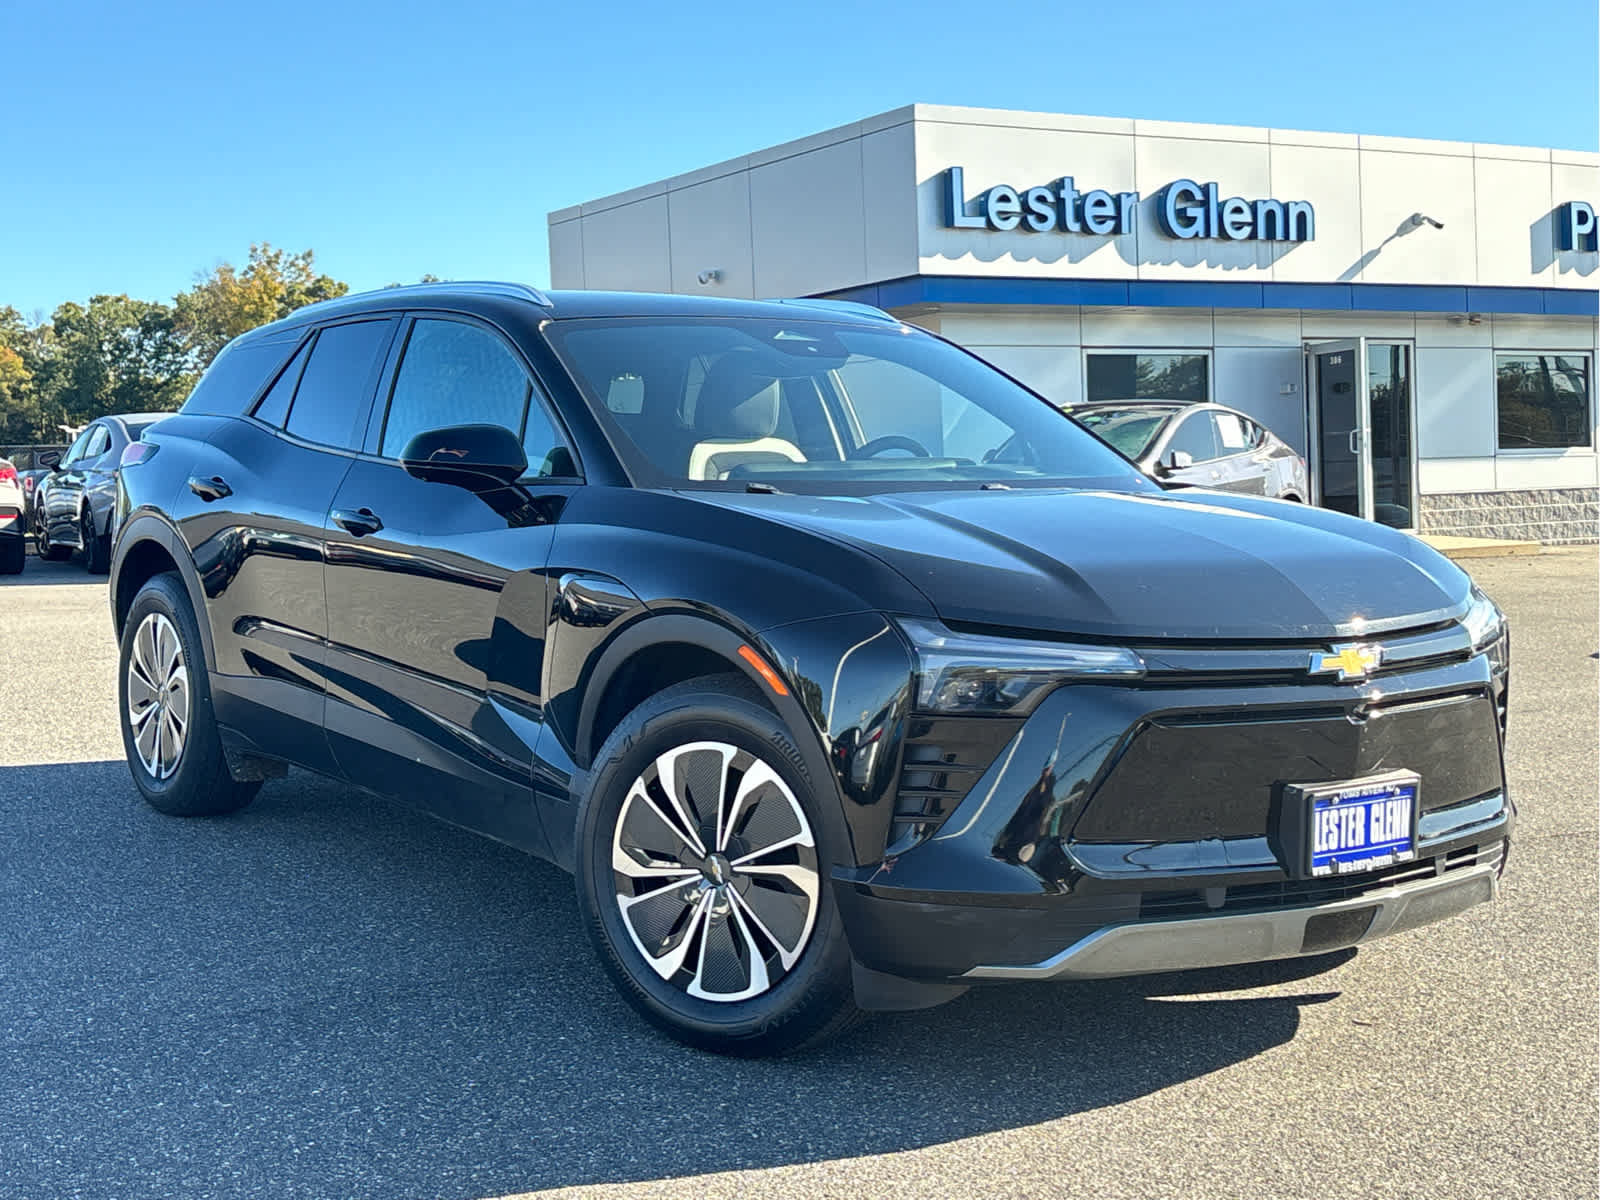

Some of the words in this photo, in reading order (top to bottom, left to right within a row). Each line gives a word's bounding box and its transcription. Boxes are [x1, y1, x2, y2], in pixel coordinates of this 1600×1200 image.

[945, 166, 1139, 234] Lester
[1159, 178, 1315, 242] Glenn
[1314, 806, 1365, 852] LESTER
[1370, 798, 1411, 844] GLENN
